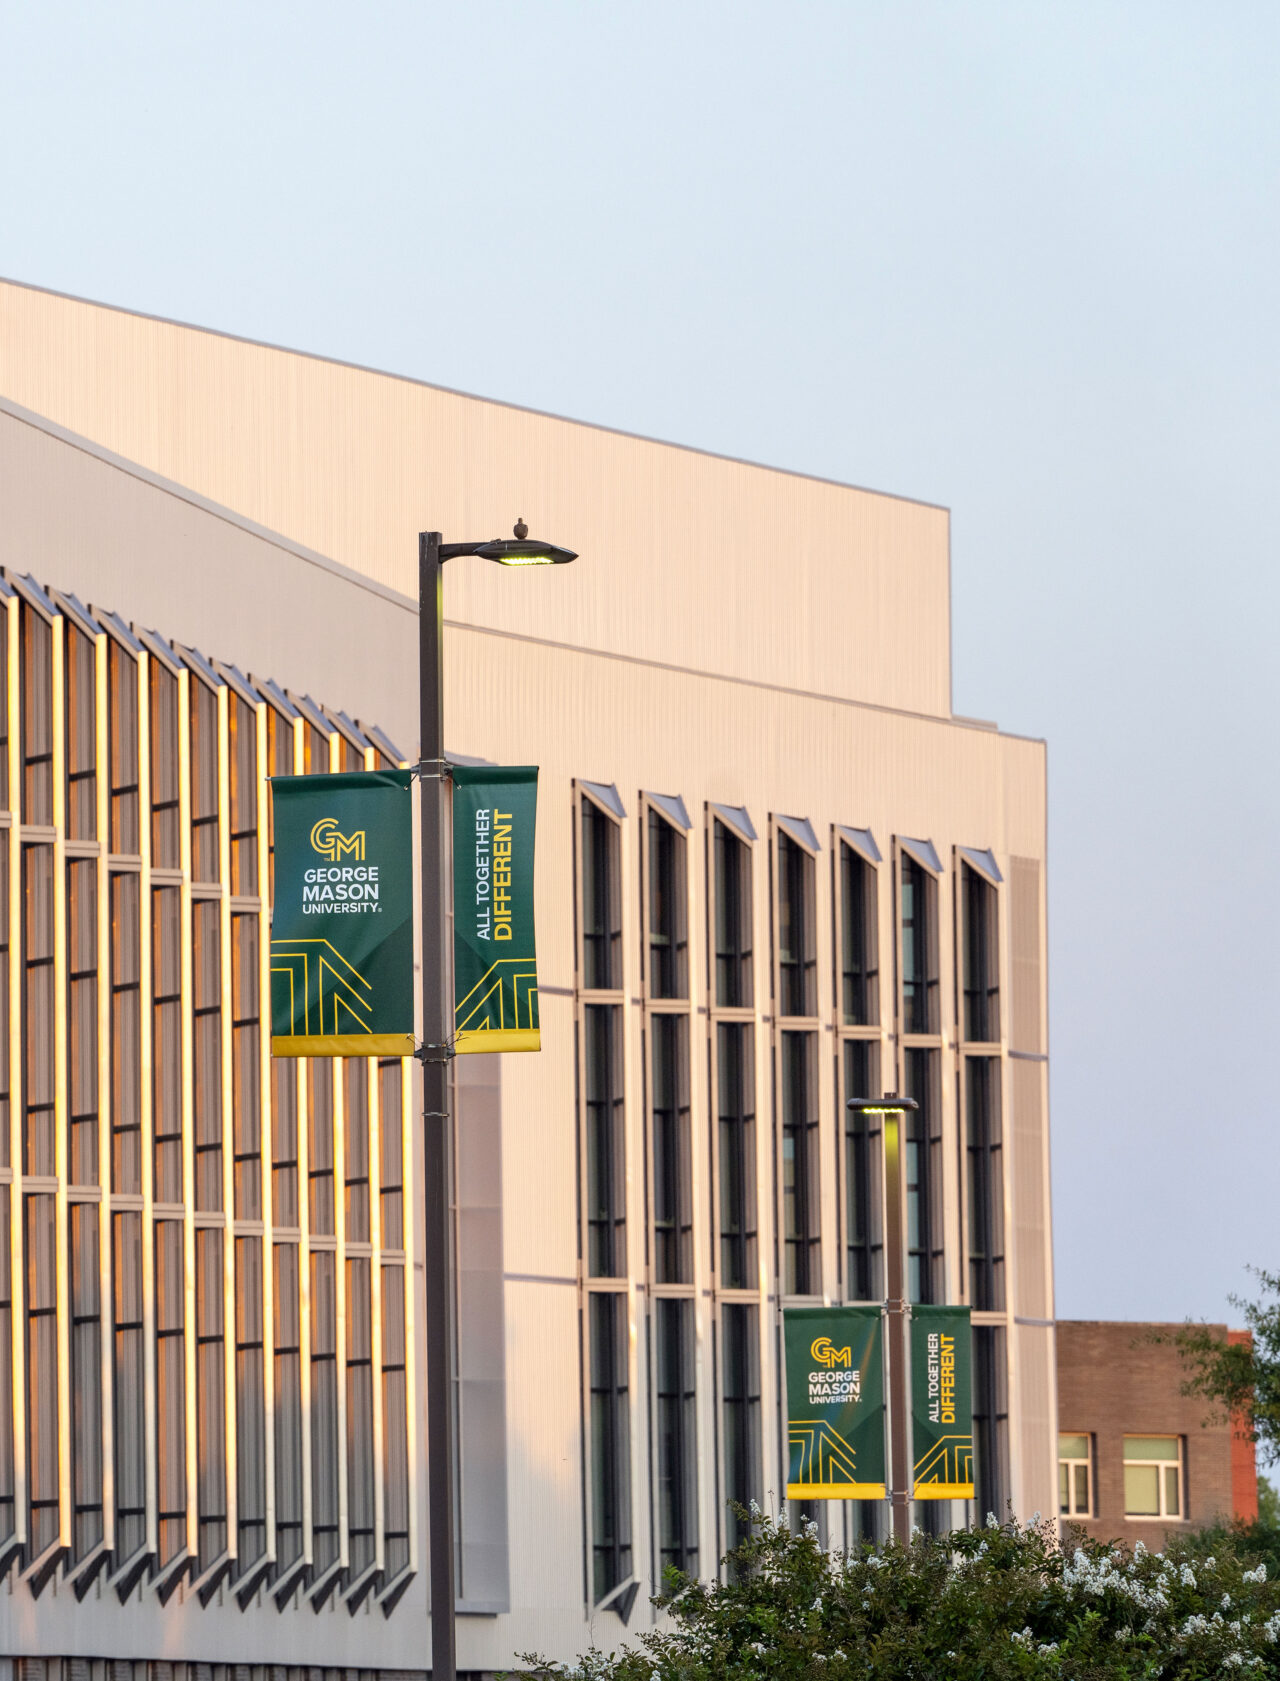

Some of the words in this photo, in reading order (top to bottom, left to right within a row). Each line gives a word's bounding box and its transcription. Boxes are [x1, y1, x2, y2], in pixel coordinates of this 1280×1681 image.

[476, 808, 490, 905] TOGETHER
[303, 866, 379, 883] GEORGE
[493, 808, 513, 941] DIFFERENT
[302, 883, 379, 902] MASON
[476, 907, 490, 940] ALL
[808, 1370, 860, 1383] GEORGE
[927, 1333, 939, 1399] TOGETHER
[940, 1333, 955, 1424] DIFFERENT
[808, 1382, 860, 1396] MASON
[928, 1400, 939, 1423] ALL
